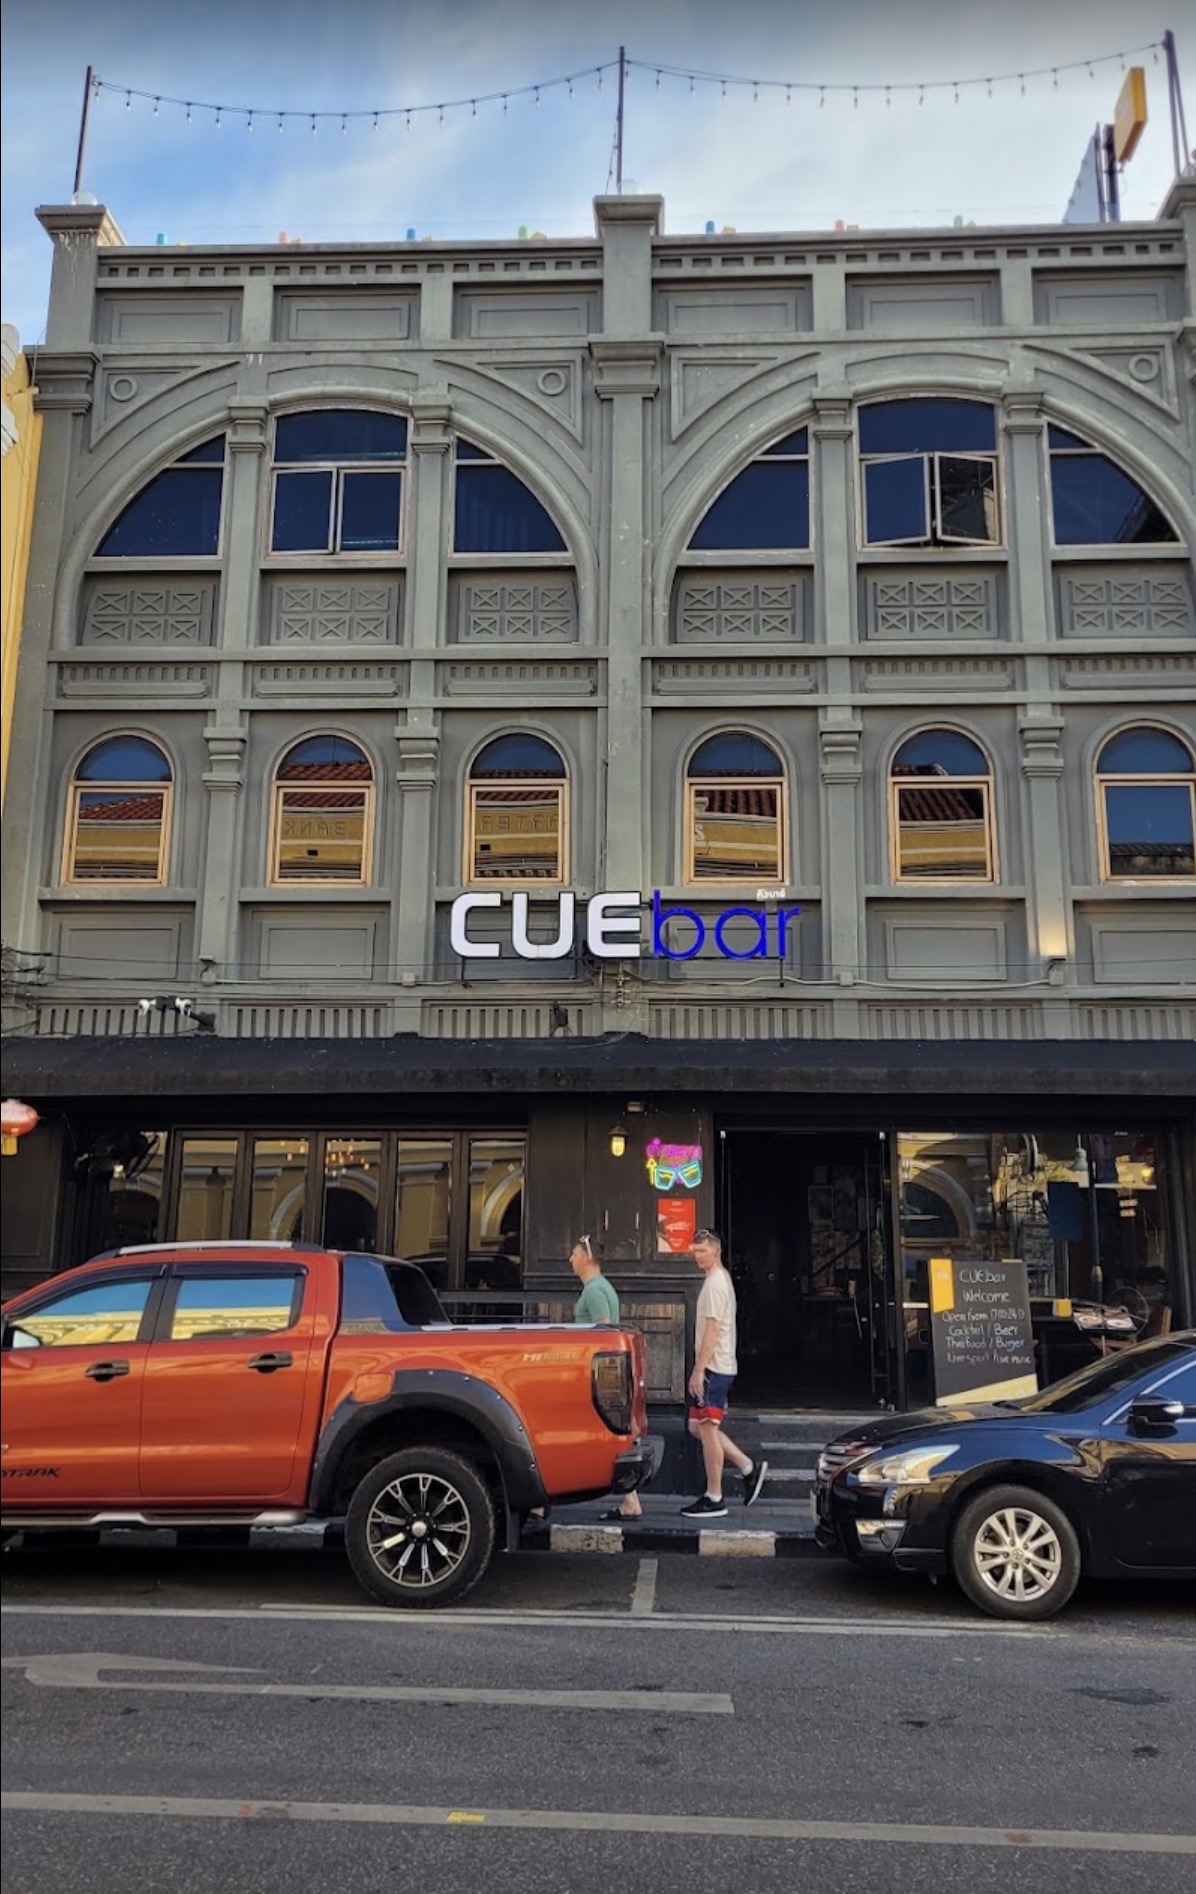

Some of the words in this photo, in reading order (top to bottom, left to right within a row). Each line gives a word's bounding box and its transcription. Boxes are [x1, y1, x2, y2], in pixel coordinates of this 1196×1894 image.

[963, 1288, 1011, 1303] Welcome
[942, 1310, 966, 1323] Open
[967, 1307, 988, 1321] from
[993, 1322, 1018, 1336] Beer
[995, 1336, 1025, 1353] Burger
